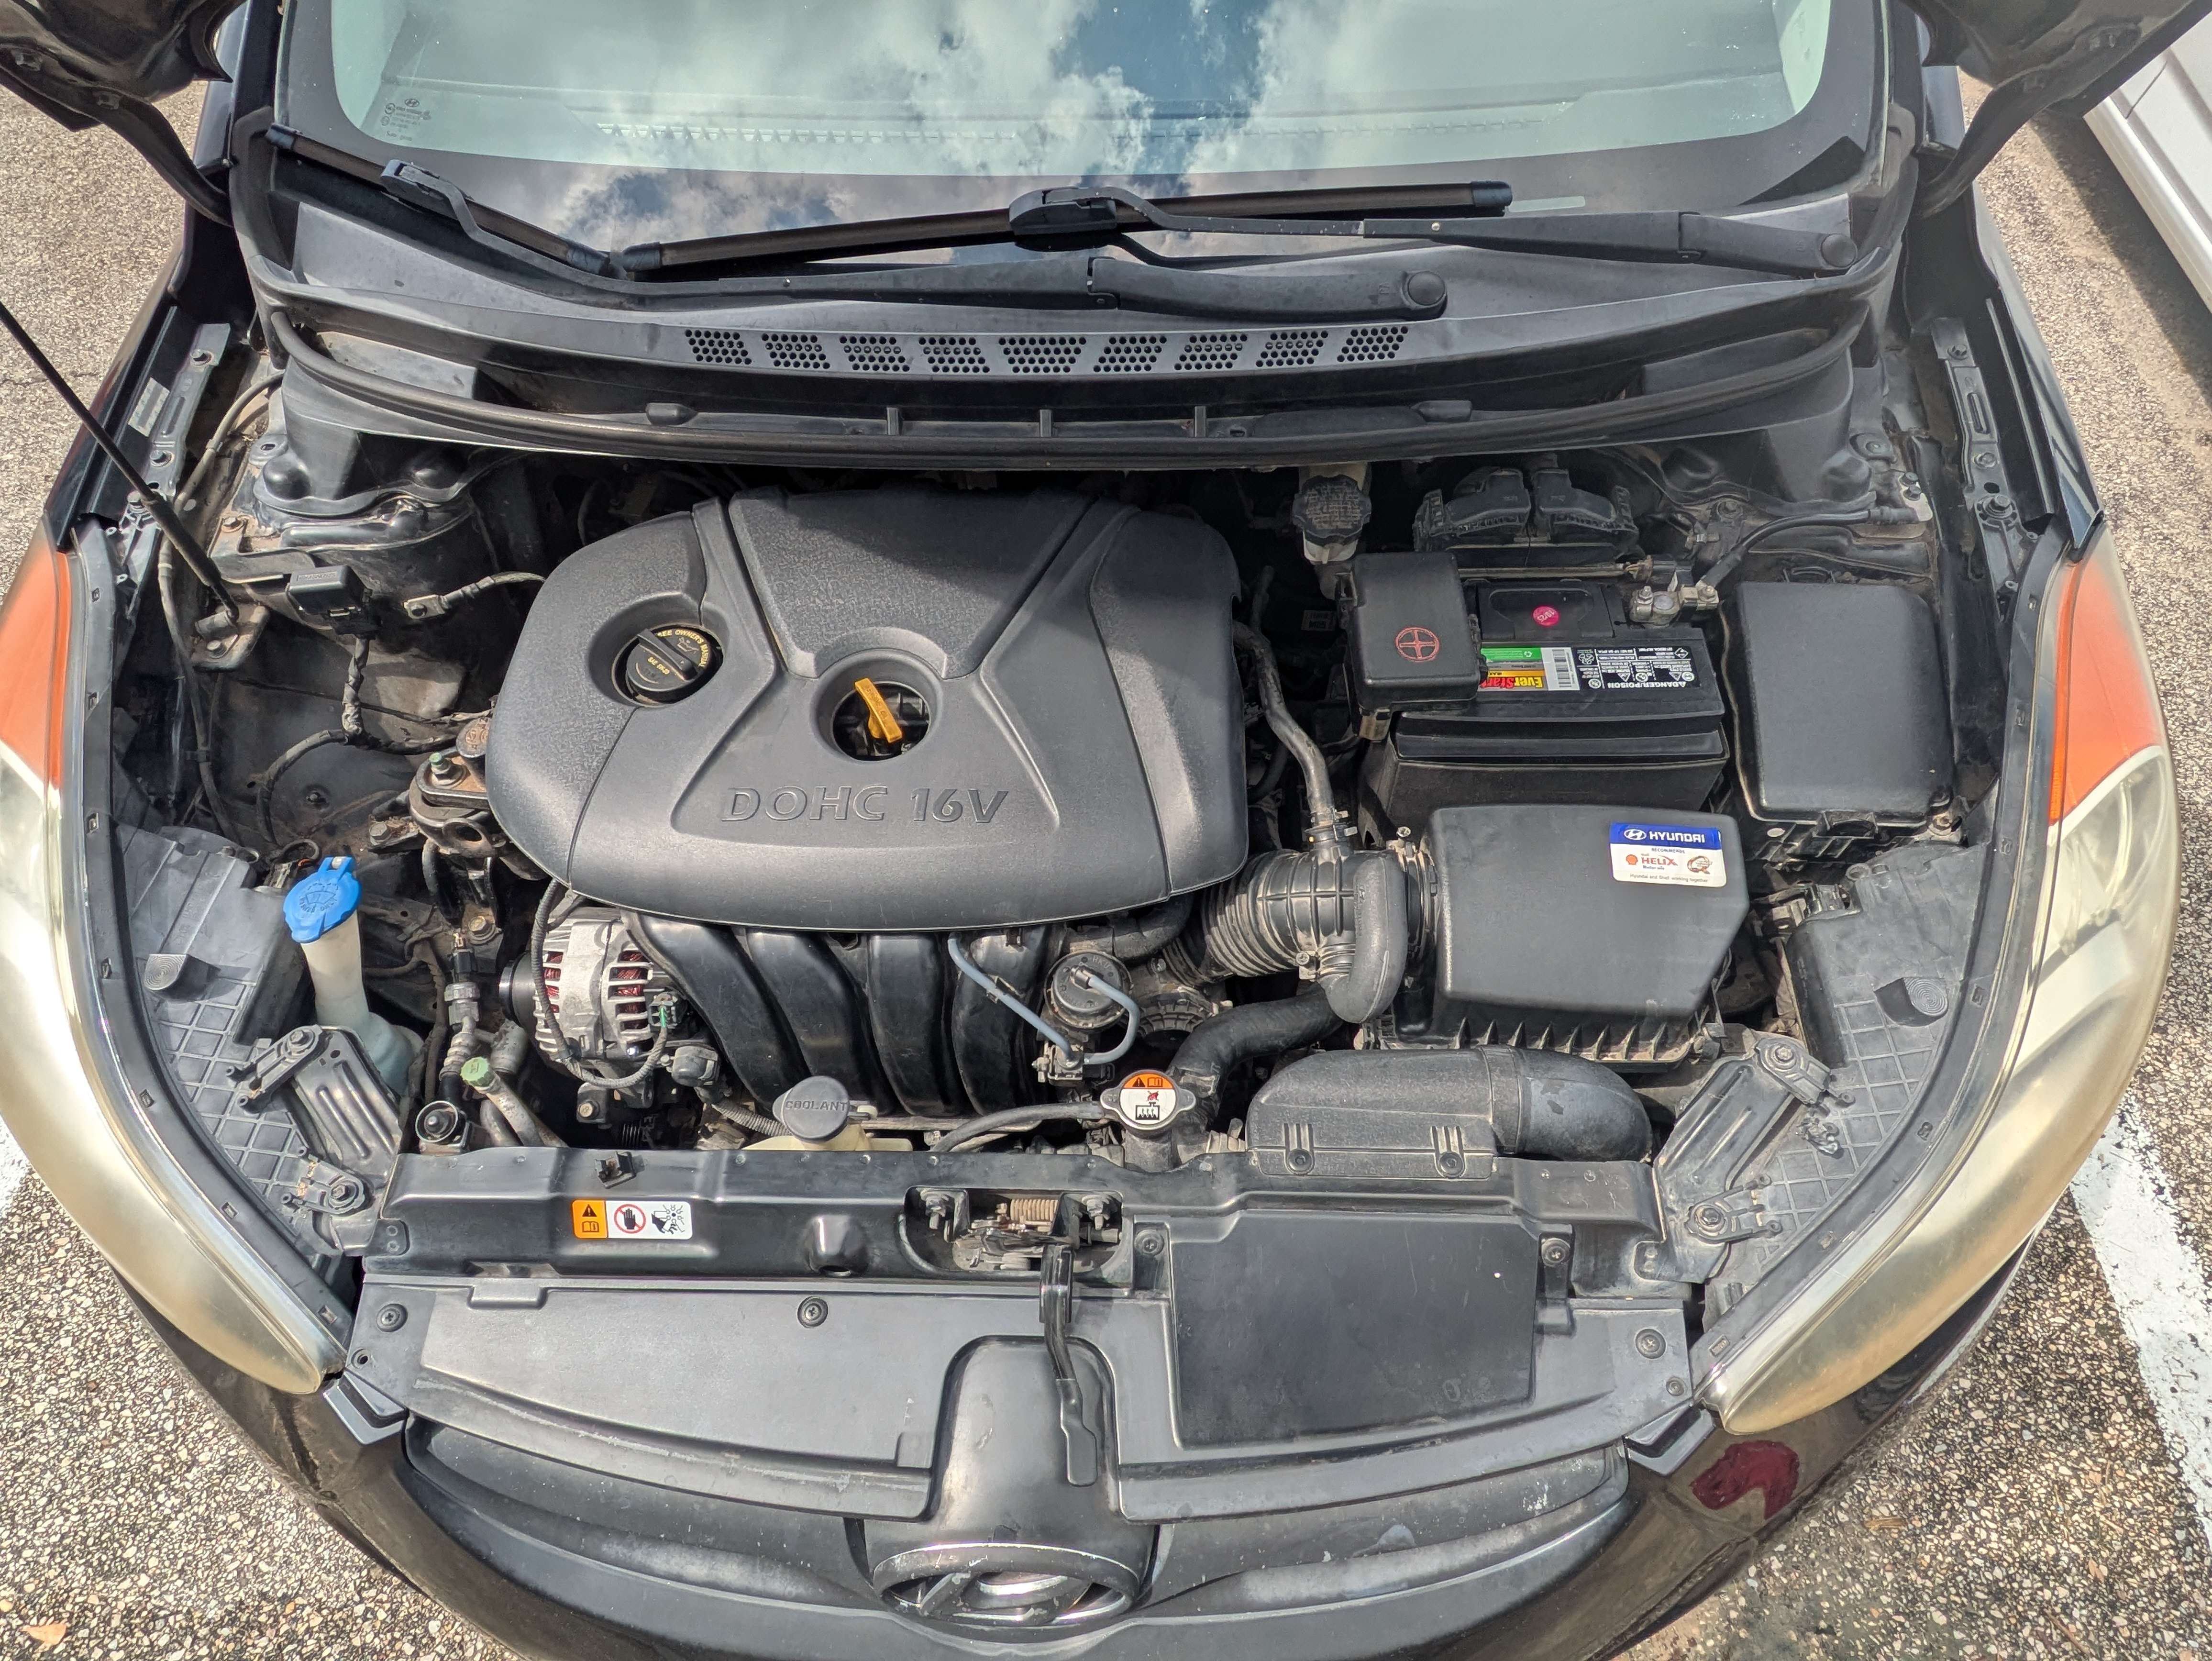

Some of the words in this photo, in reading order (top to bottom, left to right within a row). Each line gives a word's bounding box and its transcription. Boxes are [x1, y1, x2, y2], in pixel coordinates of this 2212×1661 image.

[1480, 676, 1543, 689] EverStart
[721, 785, 889, 822] DOHC
[910, 787, 1009, 823] 16V
[1649, 831, 1705, 843] HYUNDAI
[1641, 855, 1678, 866] HELIX
[785, 1100, 848, 1112] COOLANT
